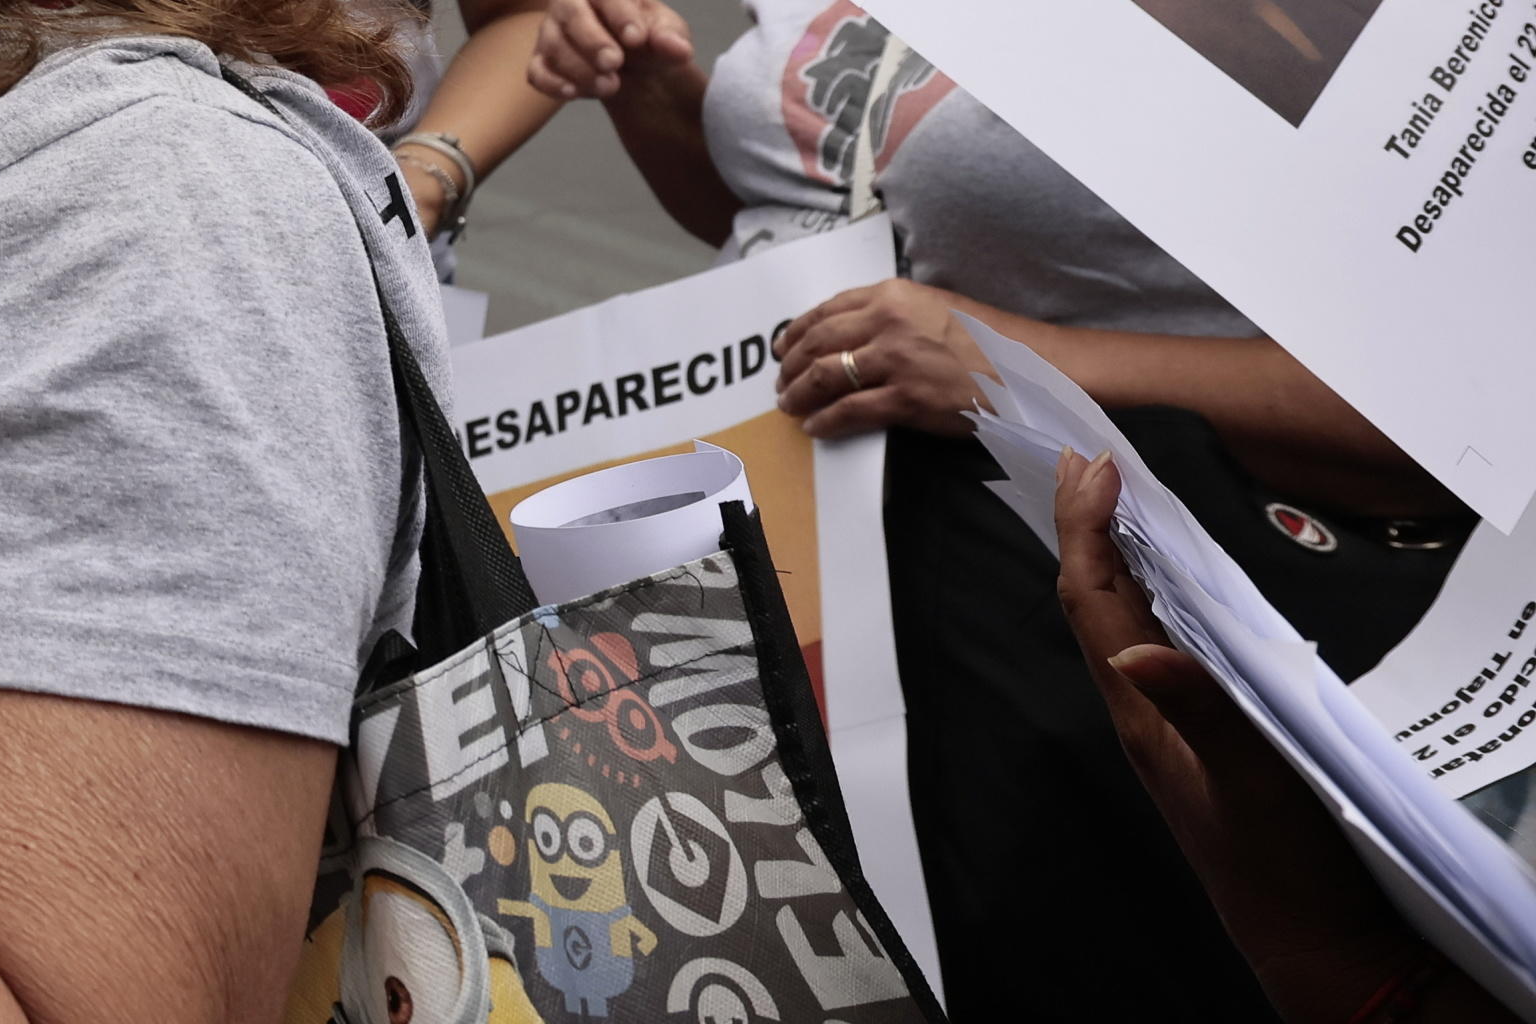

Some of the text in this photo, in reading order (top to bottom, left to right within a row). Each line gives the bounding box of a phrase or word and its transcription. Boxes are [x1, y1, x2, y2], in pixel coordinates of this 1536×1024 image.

[1383, 92, 1445, 162] Tania
[1394, 82, 1519, 254] Desaparecida
[1508, 53, 1533, 84] el
[456, 318, 793, 460] ESAPARECID
[1508, 600, 1536, 641] en
[1482, 647, 1536, 719] cido
[1441, 722, 1478, 746] el
[631, 612, 911, 1024] ELLOW
